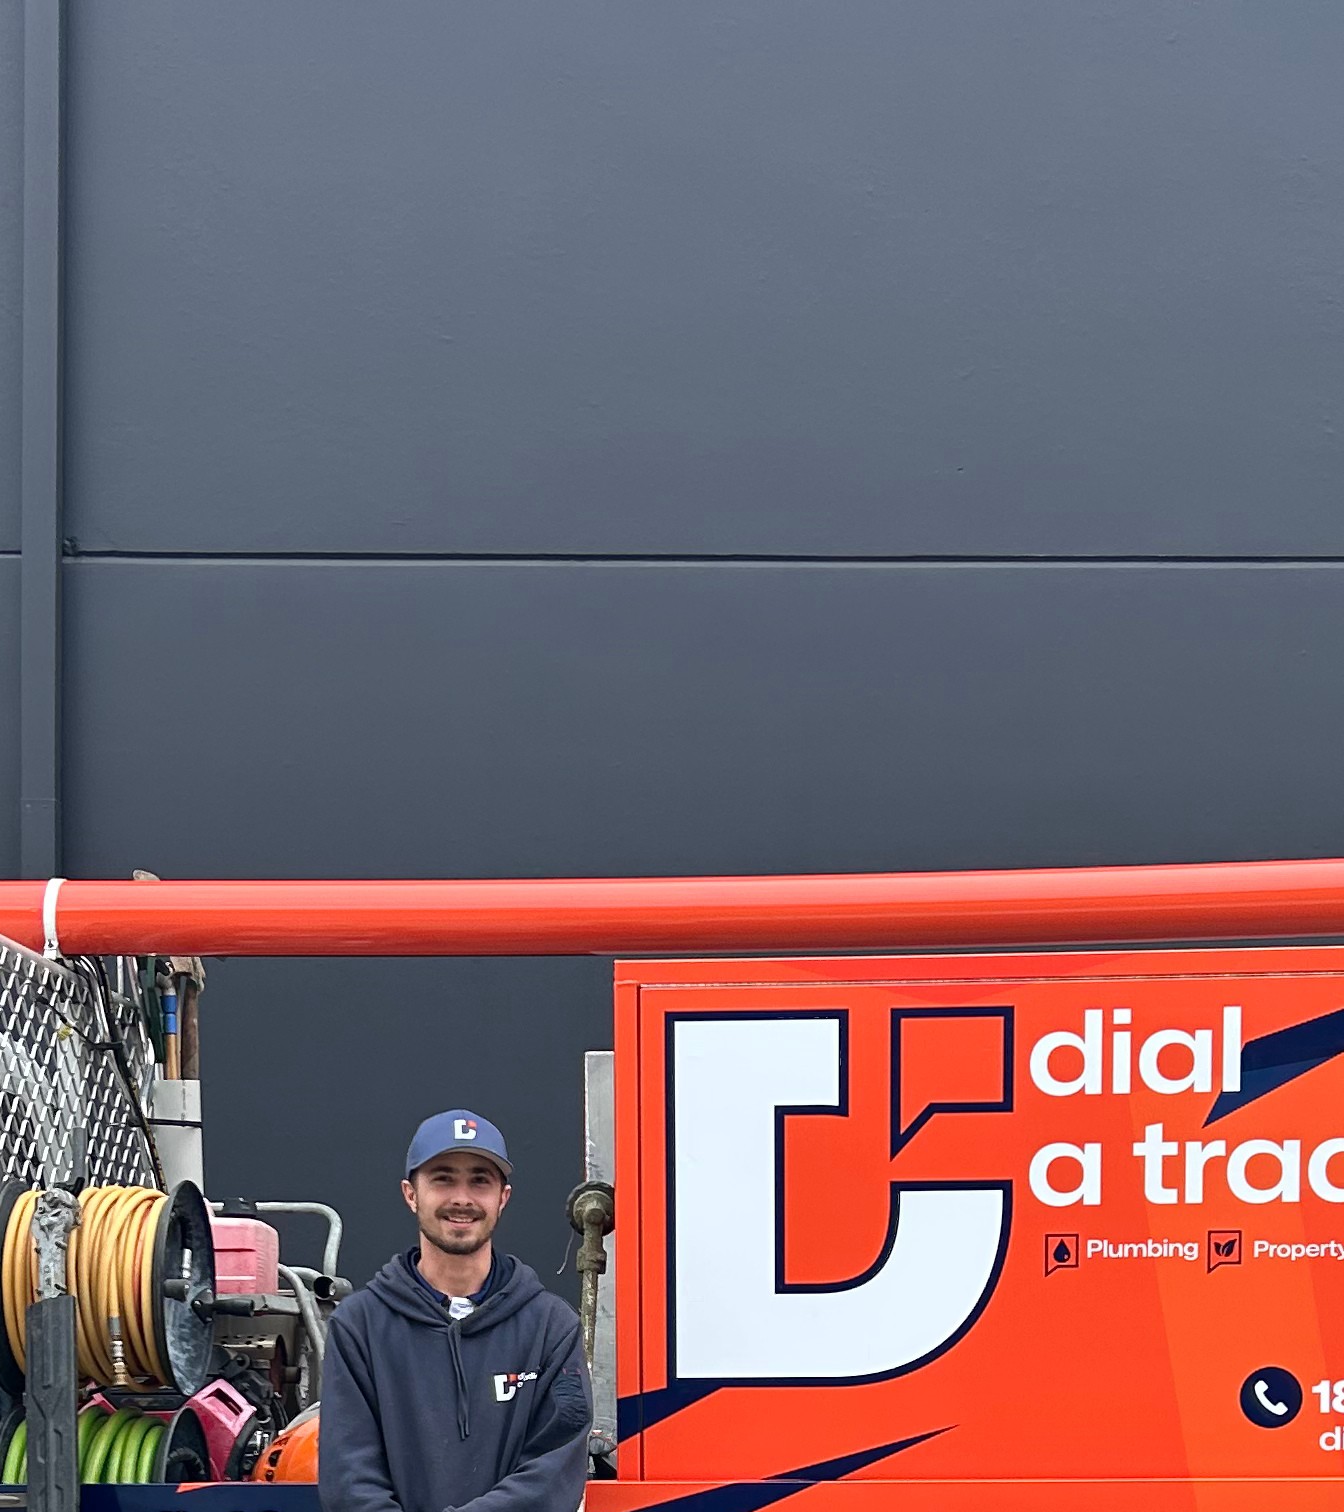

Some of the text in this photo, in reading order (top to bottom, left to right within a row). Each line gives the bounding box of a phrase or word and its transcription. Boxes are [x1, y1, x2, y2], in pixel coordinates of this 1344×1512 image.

[1030, 1006, 1242, 1096] dial
[1029, 1143, 1101, 1206] a
[1087, 1239, 1199, 1261] Plumbing
